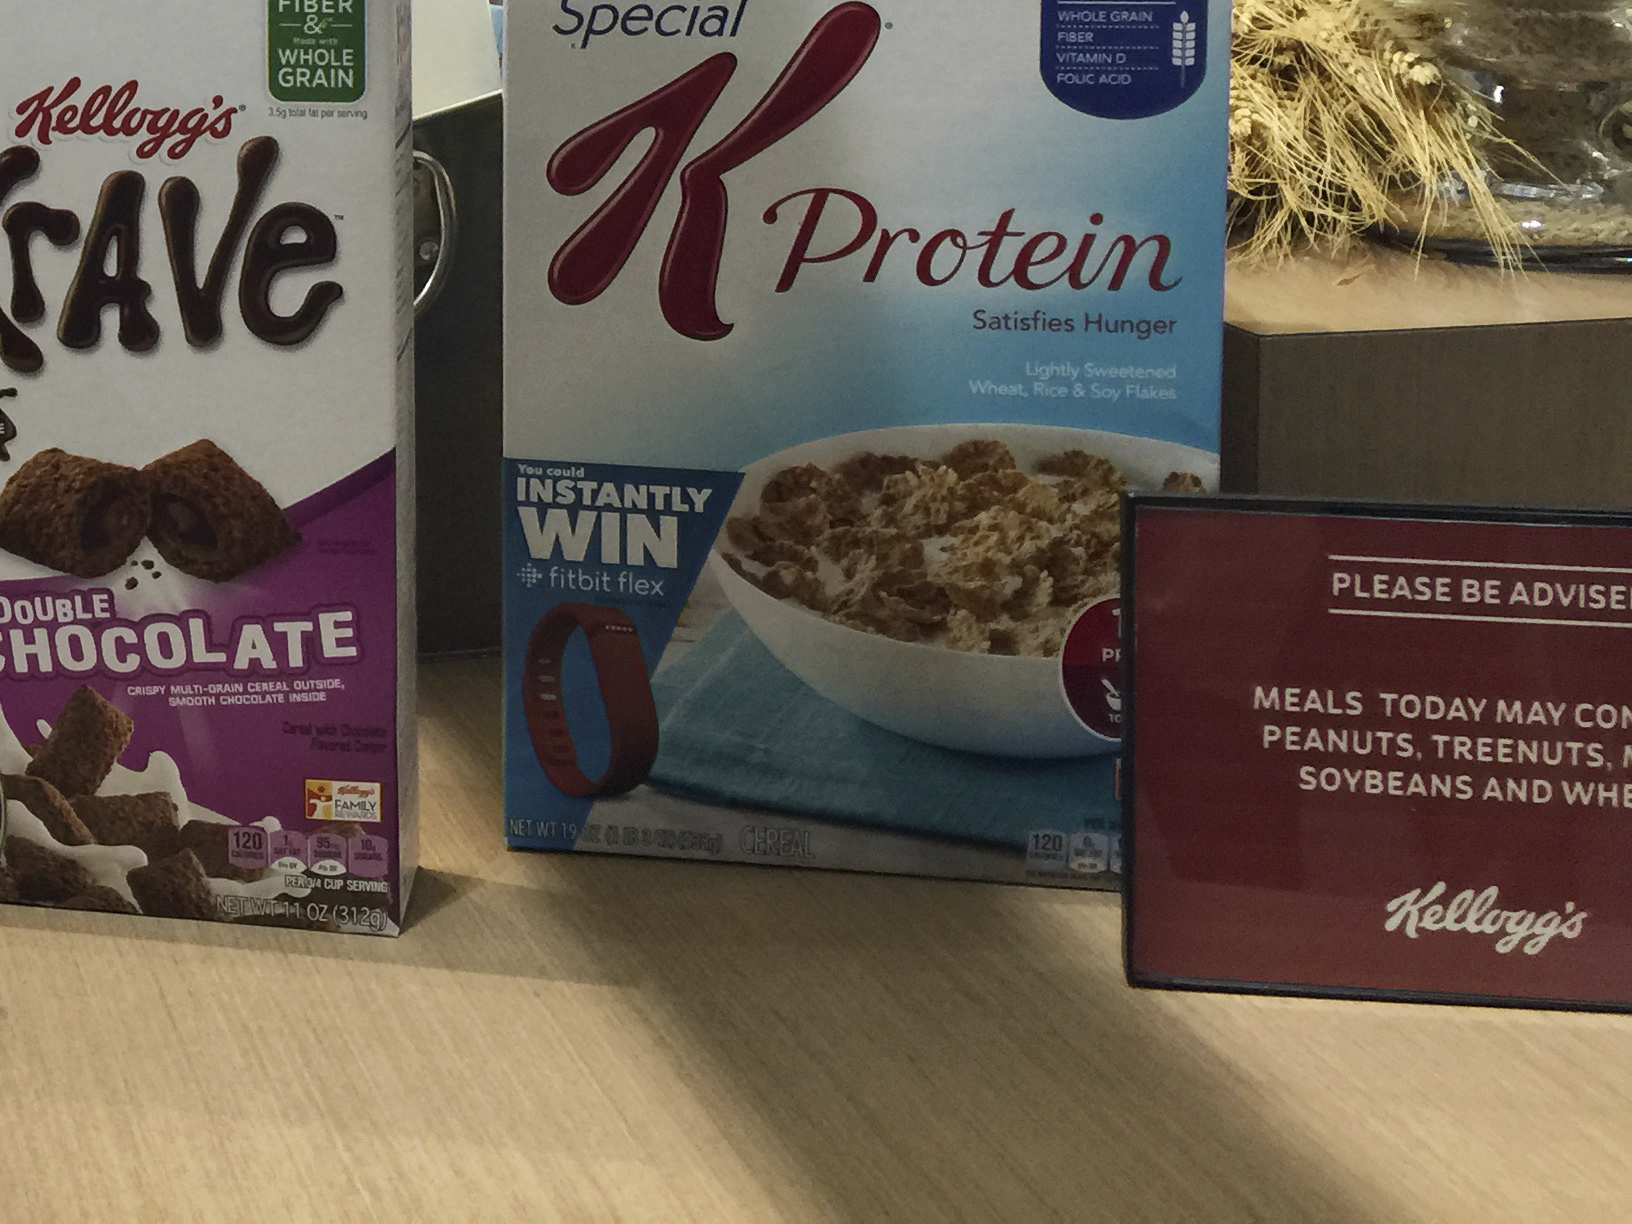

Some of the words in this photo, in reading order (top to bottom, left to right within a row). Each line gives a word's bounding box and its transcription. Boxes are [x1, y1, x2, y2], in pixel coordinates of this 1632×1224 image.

[303, 14, 322, 34] &
[1057, 11, 1106, 22] WHOLE
[1110, 11, 1153, 22] GRAIN
[1057, 32, 1093, 42] FIBER
[277, 48, 354, 66] WHOLE
[1056, 53, 1112, 63] VITAMIN
[1116, 53, 1126, 63] D
[278, 68, 354, 88] GRAIN
[1057, 74, 1095, 84] FOLIC
[1099, 74, 1132, 84] ACID
[16, 77, 236, 159] Kellogg's
[546, 1, 881, 341] K
[762, 186, 1183, 293] Protein
[972, 309, 1074, 332] Satisfies
[1084, 312, 1178, 340] Hunger
[1026, 361, 1080, 380] Lightly
[1084, 363, 1177, 378] Sweetened
[969, 379, 1028, 397] Wheat,
[1033, 382, 1068, 397] Rice
[1073, 384, 1085, 398] &
[1091, 384, 1120, 403] Soy
[1126, 385, 1177, 400] Flakes
[518, 464, 543, 475] You
[547, 467, 584, 477] could
[517, 477, 712, 513] INSTANTLY
[517, 506, 678, 569] WIN
[550, 566, 611, 593] fitbit
[618, 571, 665, 596] flex
[1332, 572, 1451, 602] PLEASE
[1462, 577, 1500, 605] BE
[128, 685, 165, 696] CRISPY
[170, 683, 243, 695] MULTI-GRAIN
[247, 681, 289, 692] CEREAL
[294, 679, 345, 691] OUTSIDE,
[168, 696, 215, 706] SMOOTH
[220, 694, 284, 704] CHOCOLATE
[289, 692, 326, 702] INSIDE
[1253, 686, 1363, 716] MEALS
[1380, 692, 1486, 723] TODAY
[1496, 700, 1567, 726] MAY
[1263, 725, 1422, 760] PEANUTS,
[1432, 734, 1612, 771] TREENUTS,
[1299, 765, 1473, 801] SOYBEANS
[1483, 776, 1552, 804] AND
[335, 800, 377, 811] FAMILY
[509, 819, 532, 837] NET
[535, 821, 556, 837] WT
[561, 822, 577, 840] 19
[233, 832, 262, 850] 120
[740, 827, 815, 859] CEREAL
[1032, 834, 1062, 851] 120
[285, 876, 305, 888] PER
[307, 877, 321, 888] 3/4
[324, 879, 343, 890] CUP
[347, 880, 388, 893] SERVING
[217, 895, 248, 915] NET
[250, 898, 278, 915] WT
[283, 901, 300, 918] 11
[307, 903, 328, 922] OZ
[333, 905, 387, 931] (312g)
[1385, 881, 1588, 955] Kellogg's
